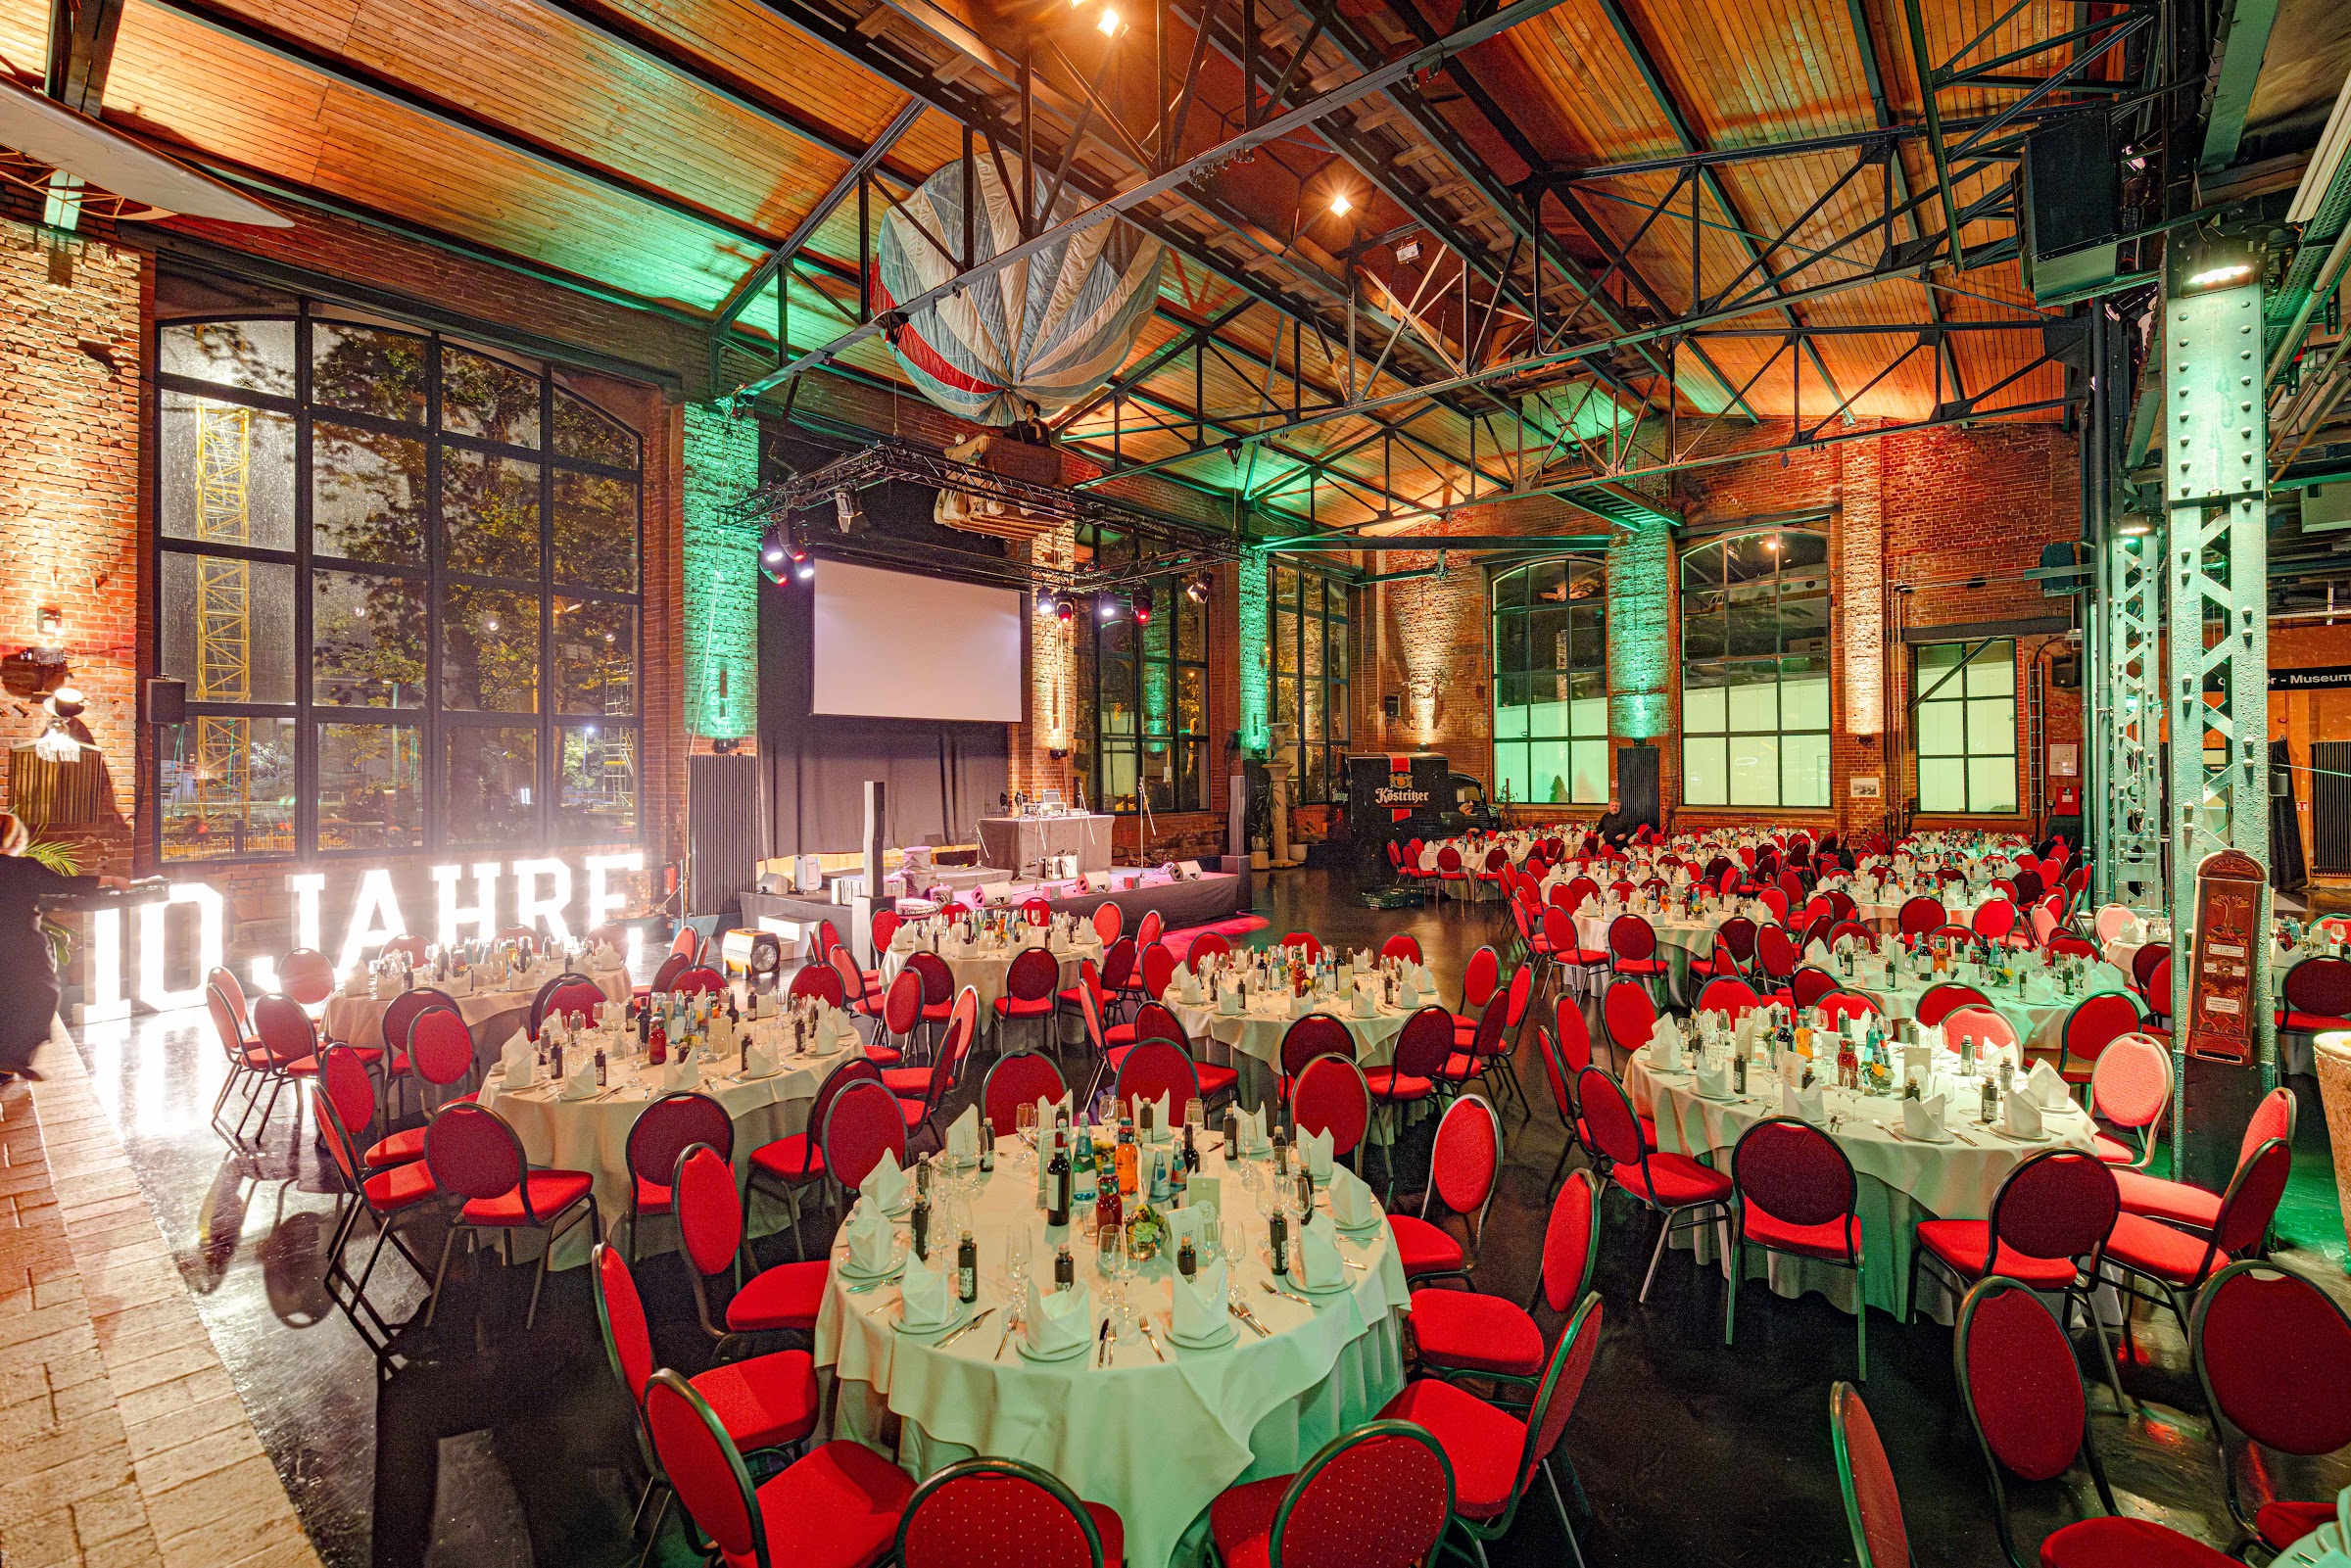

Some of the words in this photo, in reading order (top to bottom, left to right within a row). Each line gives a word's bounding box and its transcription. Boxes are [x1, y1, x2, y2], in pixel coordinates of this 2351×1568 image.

[2290, 673, 2351, 685] Museum
[1374, 787, 1429, 803] Köstritzer
[76, 881, 223, 1024] 10
[251, 853, 644, 993] JAHRE
